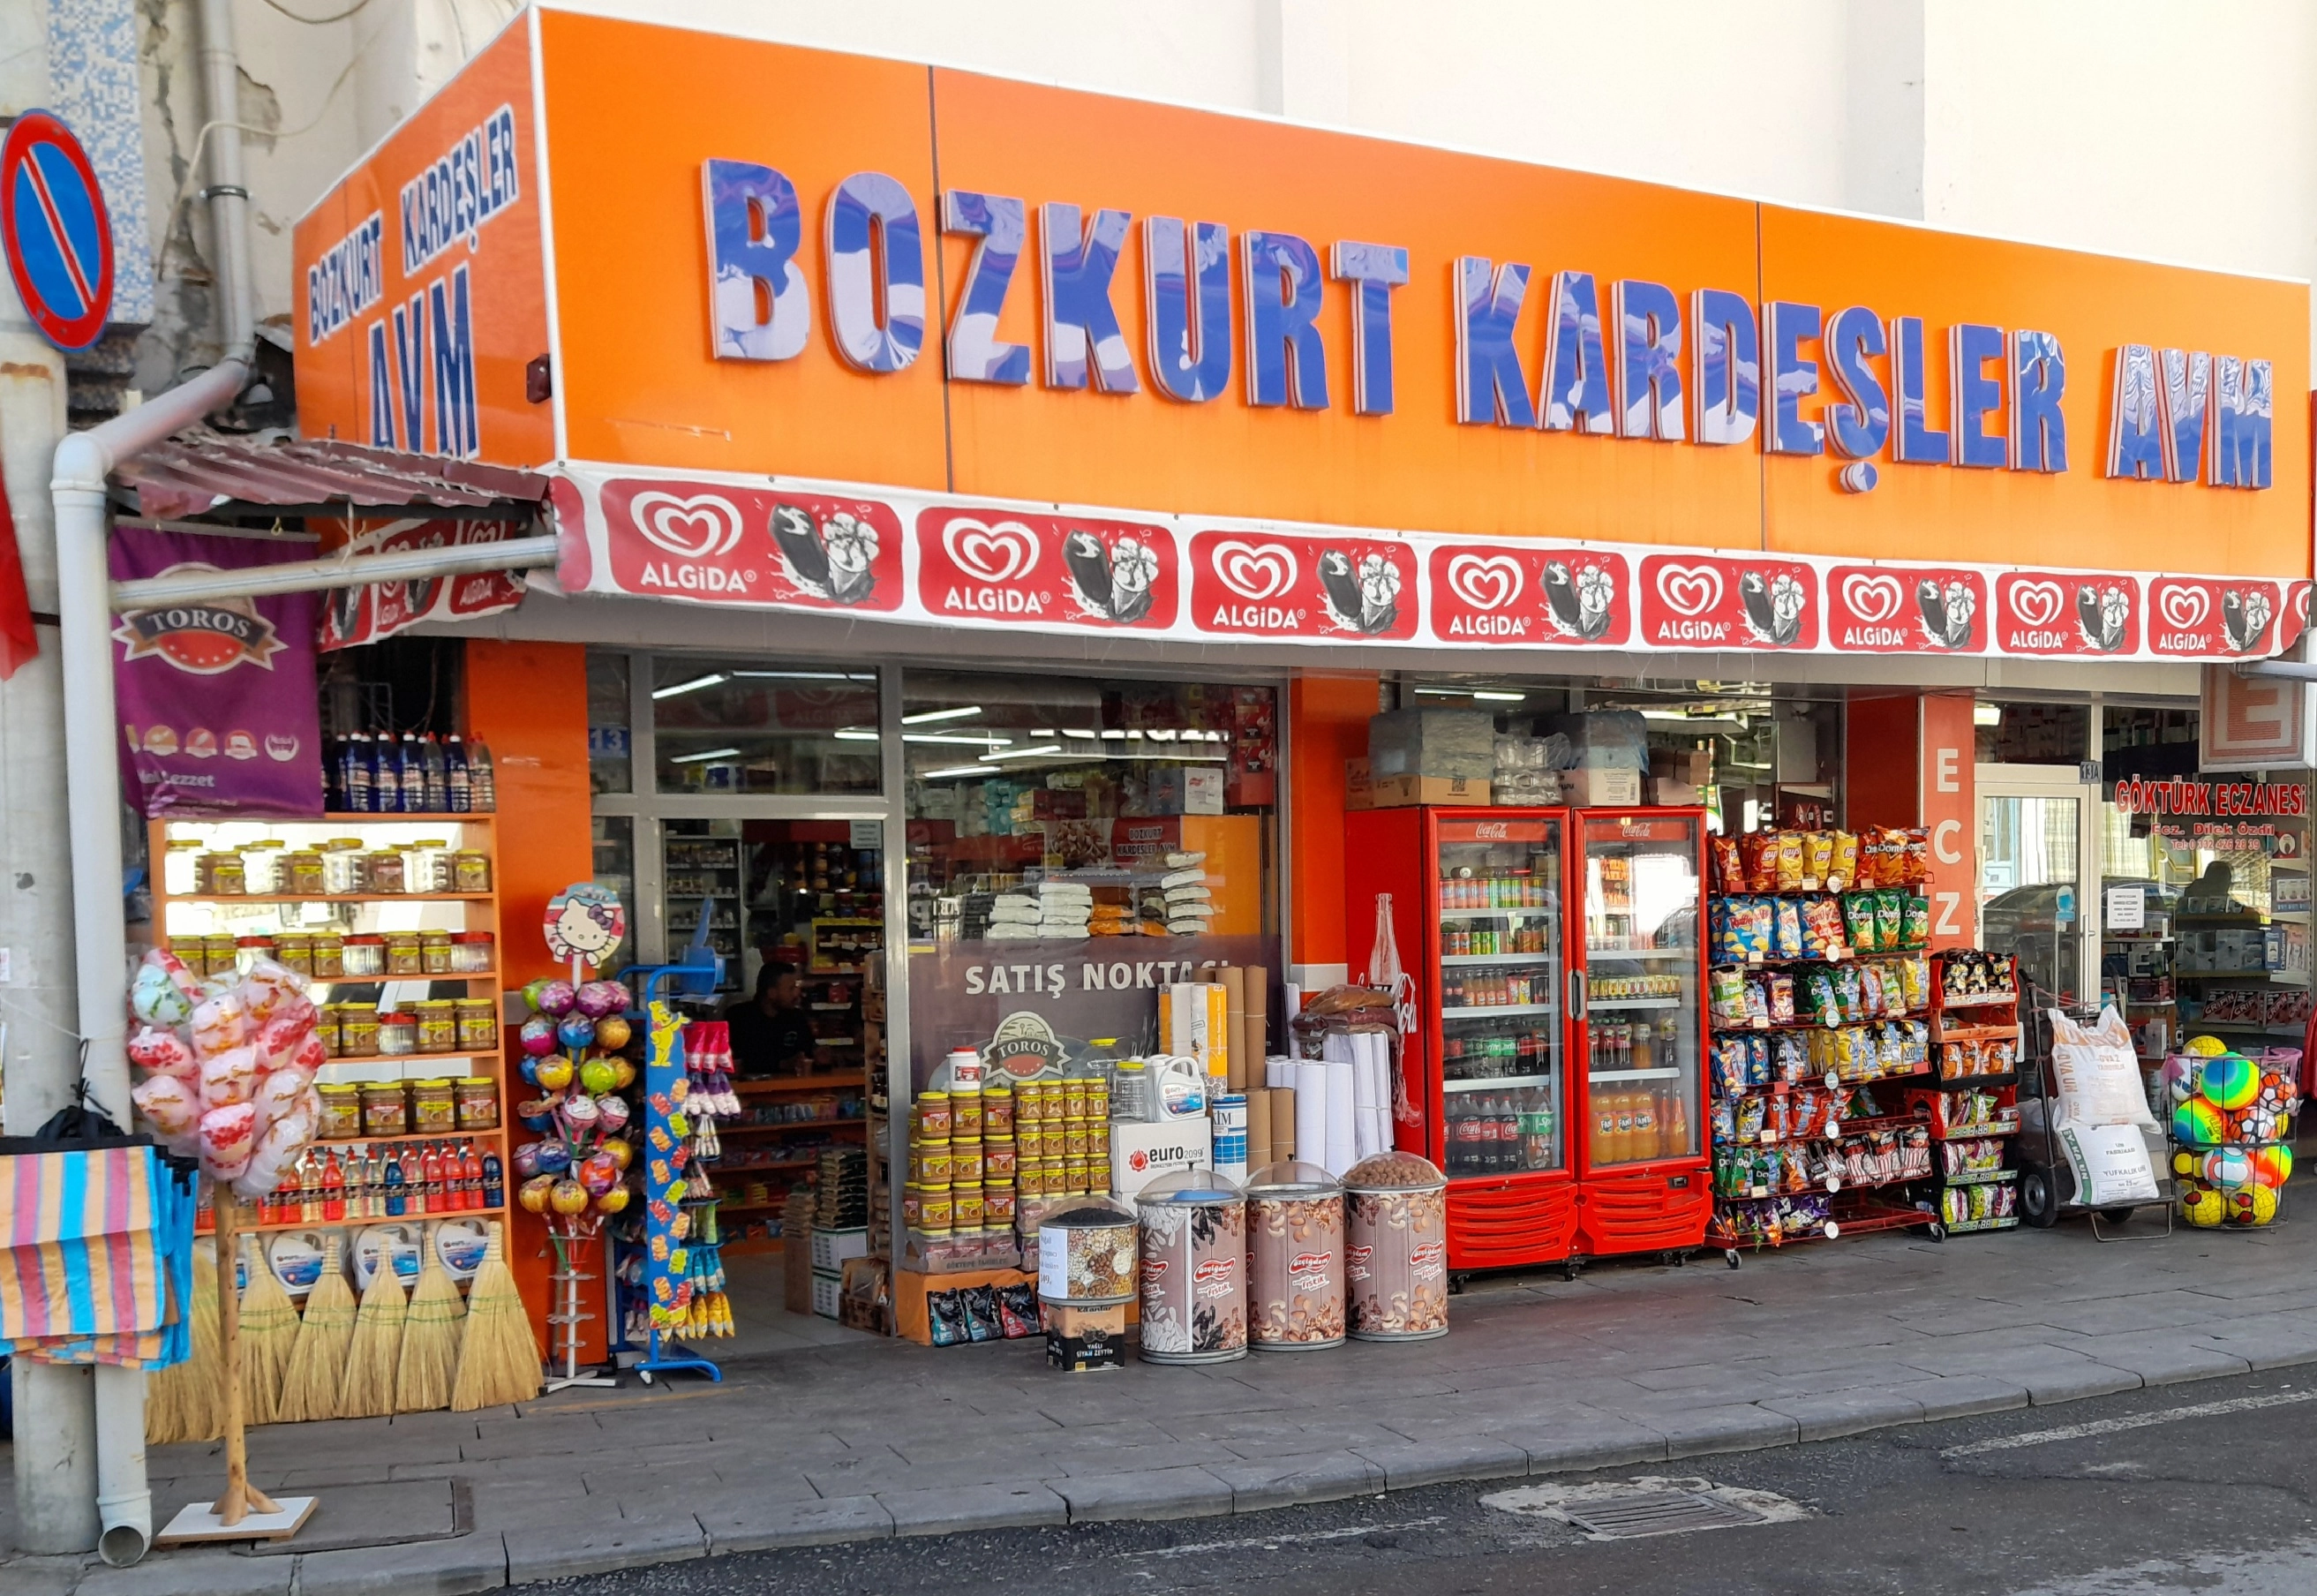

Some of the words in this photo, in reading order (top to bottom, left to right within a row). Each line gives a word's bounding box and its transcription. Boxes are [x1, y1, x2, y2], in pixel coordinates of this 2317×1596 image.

[308, 209, 383, 348] BOZKURT
[401, 102, 519, 278] KARDEŞLER
[701, 158, 1410, 417] BOZKURT
[1452, 255, 2069, 494] KARDEŞLER
[2104, 343, 2273, 489] AVM
[368, 260, 480, 462] AVM
[146, 608, 252, 638] TOROS
[591, 731, 623, 749] 13
[162, 770, 215, 787] ezzet
[2115, 773, 2211, 816] GÖKTÜRK
[1129, 826, 1163, 839] BOZKURT
[2150, 823, 2185, 836] Ecz.
[2193, 823, 2233, 836] Dilek
[2238, 821, 2276, 836] Özdil
[2189, 839, 2195, 849] 0
[2216, 839, 2233, 850] 426
[2235, 839, 2246, 850] 28
[2248, 839, 2261, 850] 39
[965, 964, 1066, 999] SATIŞ
[1082, 960, 1229, 991] NOKTA
[997, 1041, 1050, 1059] TOROS
